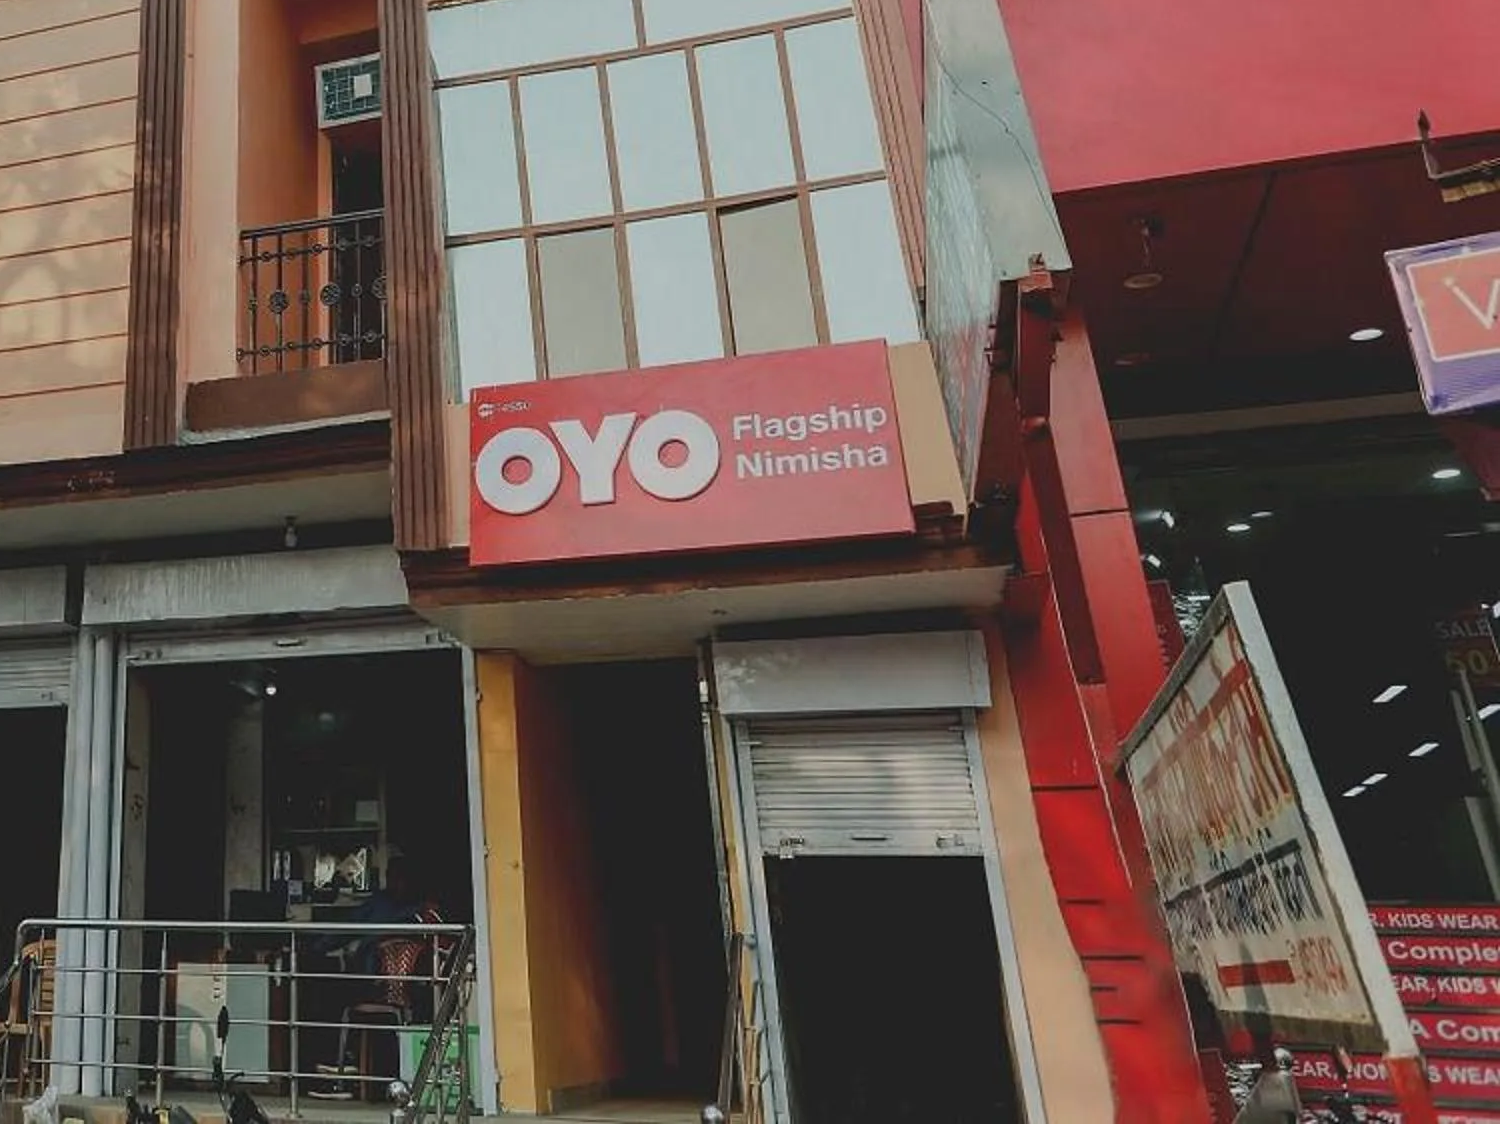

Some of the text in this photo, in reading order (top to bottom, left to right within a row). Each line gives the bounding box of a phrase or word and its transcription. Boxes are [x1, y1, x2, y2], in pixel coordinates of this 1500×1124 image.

[733, 403, 887, 440] Flagship
[475, 408, 720, 515] OYO
[736, 443, 888, 479] Nimisha
[1388, 913, 1435, 928] KIDS
[1387, 941, 1500, 965] Comple
[1437, 977, 1488, 995] KIDS
